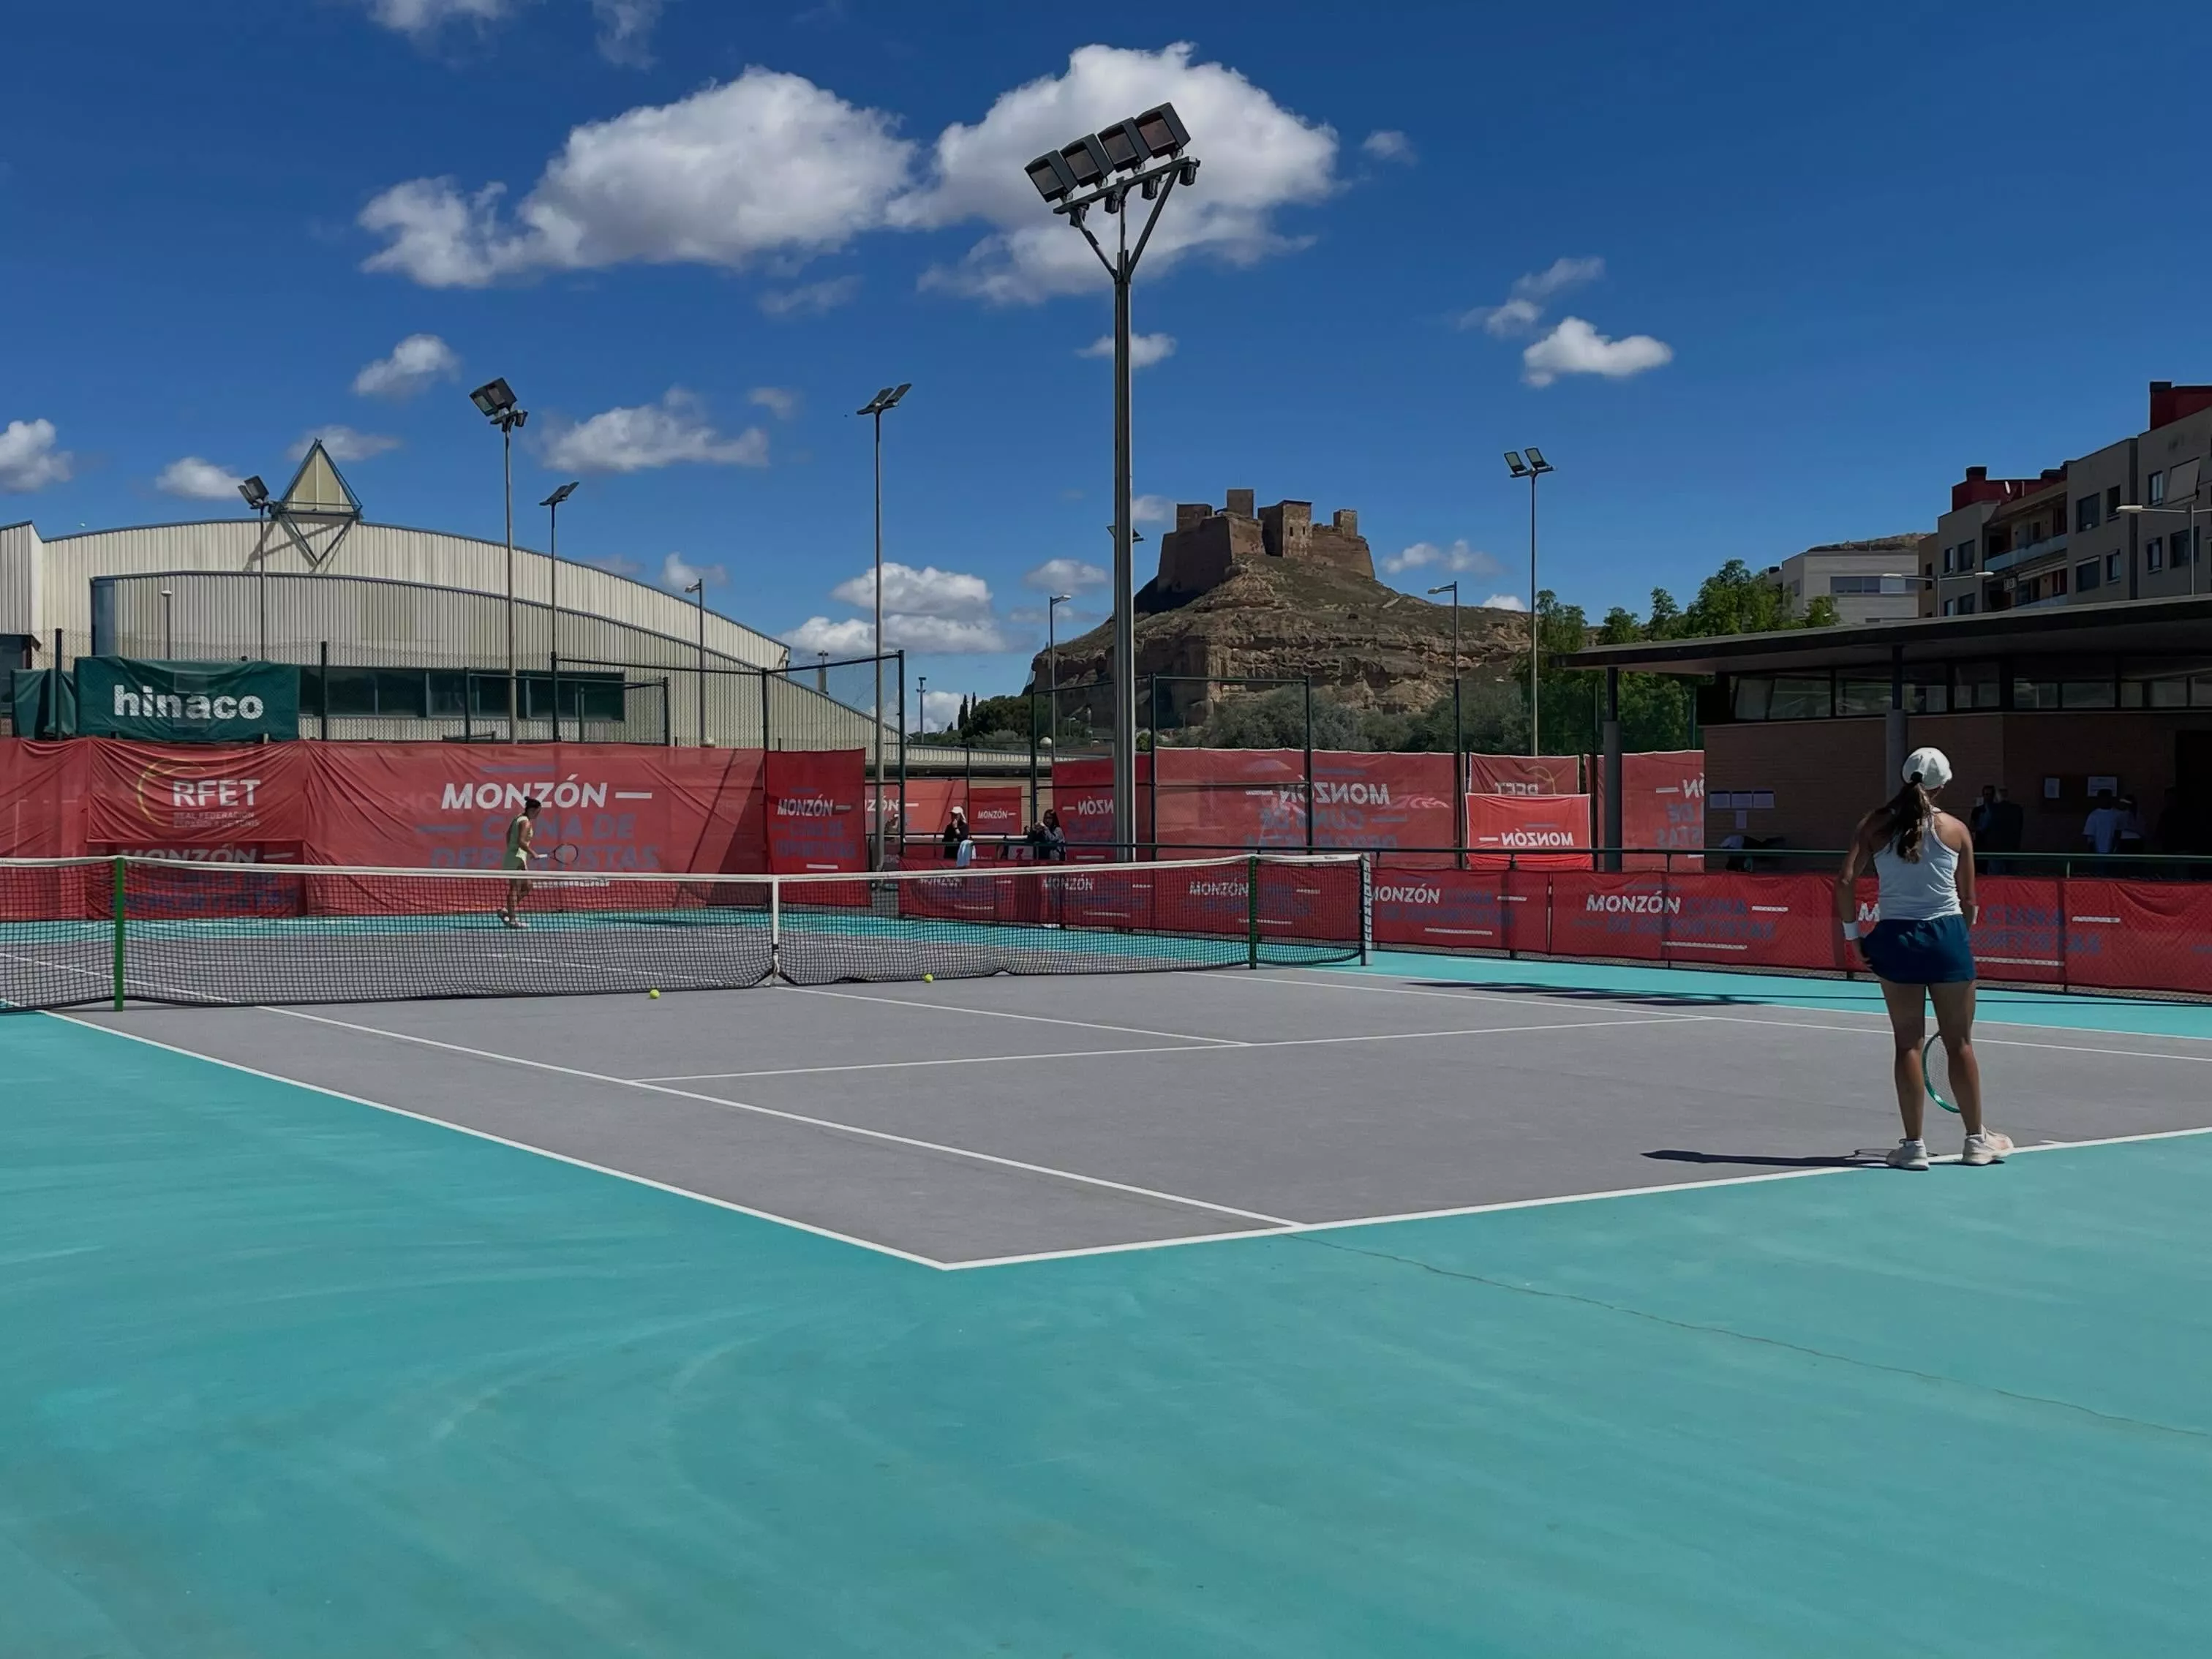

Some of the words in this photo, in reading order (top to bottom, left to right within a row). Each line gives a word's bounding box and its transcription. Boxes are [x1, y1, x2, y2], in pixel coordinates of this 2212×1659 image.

[113, 684, 264, 720] hinaco
[173, 778, 262, 806] RFET
[440, 774, 608, 810] MONZÓN
[777, 794, 834, 817] MONZÓN
[977, 808, 1008, 819] MONZÓN
[481, 813, 582, 840] CNA
[592, 813, 636, 840] DE
[1586, 890, 1682, 914] MONZÓN
[1985, 904, 2065, 927] CUNA
